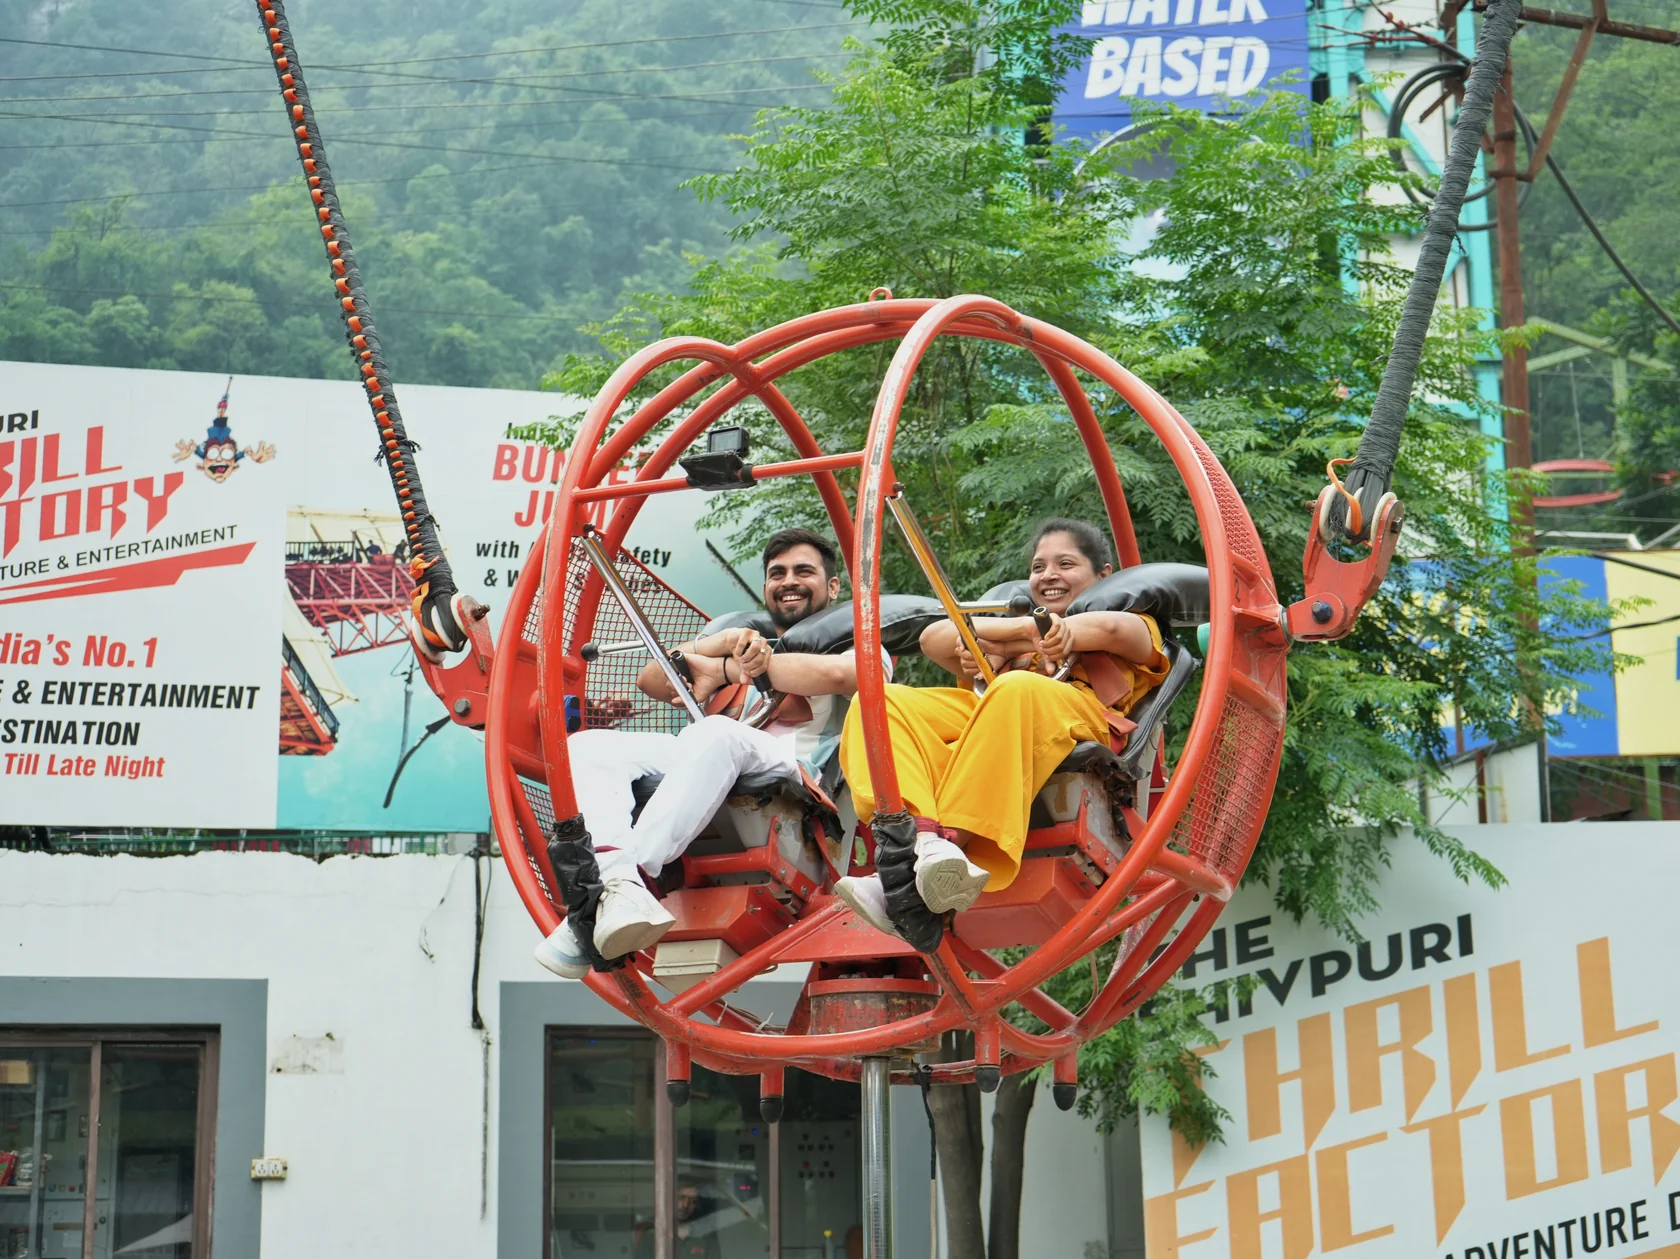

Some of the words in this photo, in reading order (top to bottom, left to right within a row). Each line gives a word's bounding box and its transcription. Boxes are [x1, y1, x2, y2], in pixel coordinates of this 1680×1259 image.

[1084, 36, 1270, 99] BASED
[0, 409, 39, 433] RI
[57, 555, 70, 570] &
[76, 524, 238, 567] ENTERTAINMENT
[476, 540, 520, 559] with
[483, 568, 498, 587] &
[12, 679, 32, 704] &
[41, 680, 261, 710] ENTERTAINMENT
[0, 719, 141, 746] STINATION
[4, 753, 40, 775] Till
[46, 754, 97, 777] Late
[104, 756, 166, 780] Night
